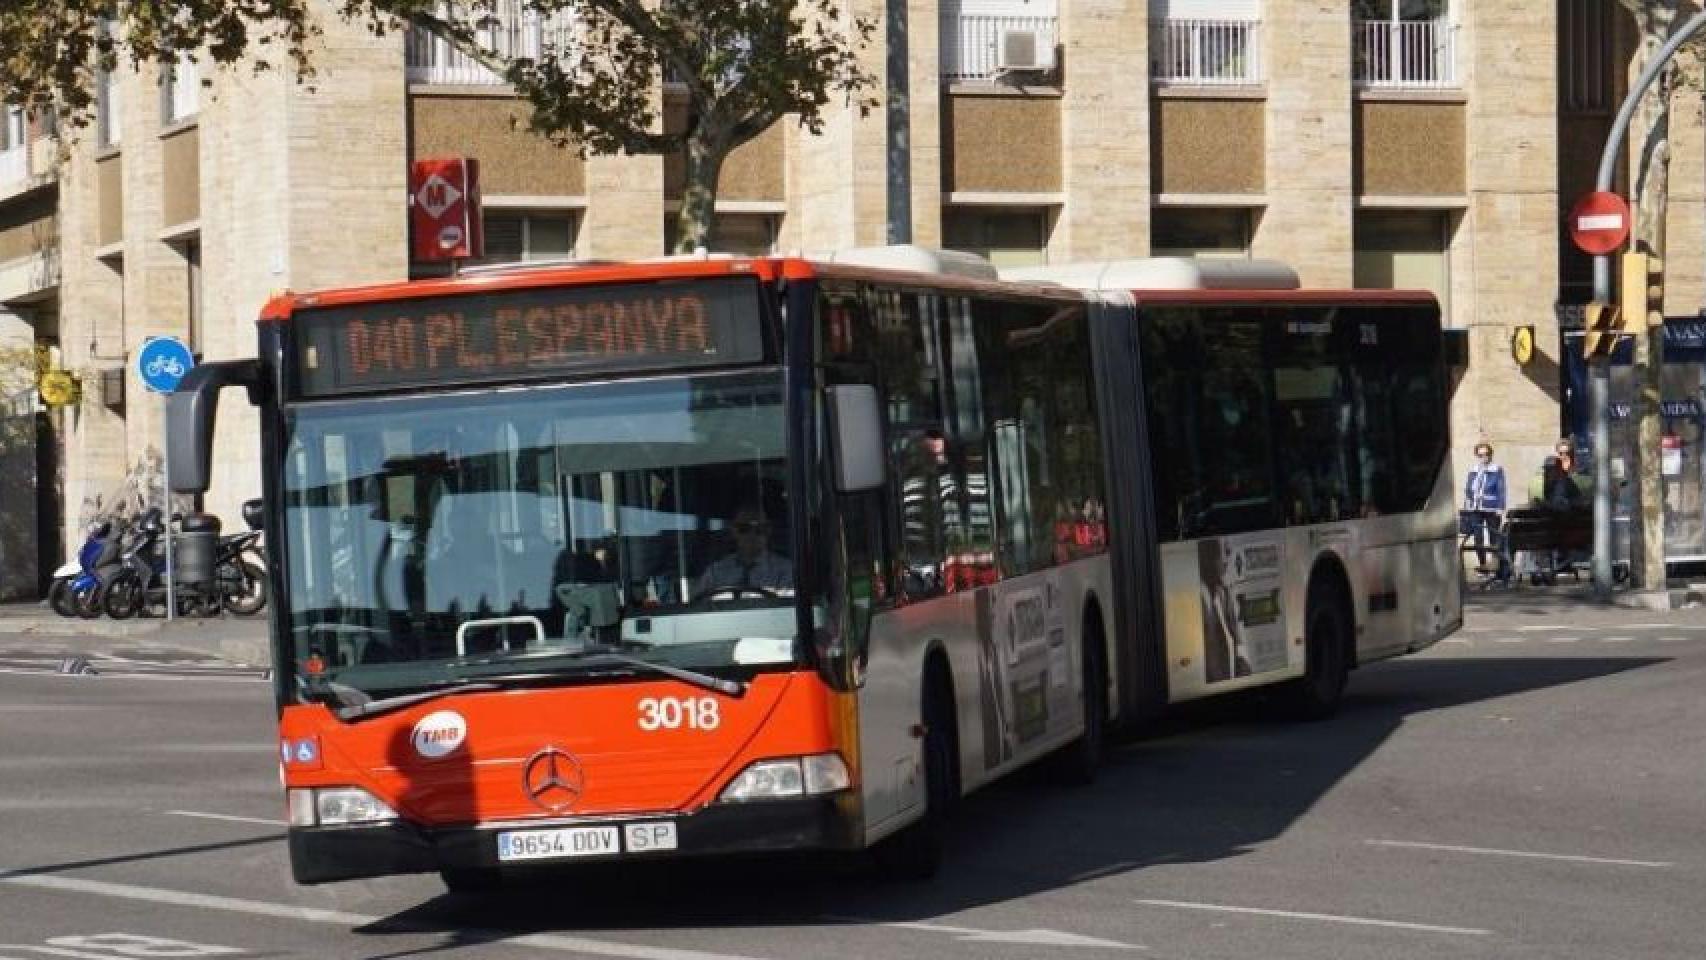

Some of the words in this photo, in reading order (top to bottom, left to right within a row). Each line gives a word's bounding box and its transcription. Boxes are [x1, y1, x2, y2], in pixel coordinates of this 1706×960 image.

[425, 182, 447, 207] M
[637, 696, 720, 731] 3018
[421, 727, 459, 745] TMB
[511, 833, 565, 856] 9654
[573, 829, 612, 851] DDV
[632, 826, 669, 849] SP
